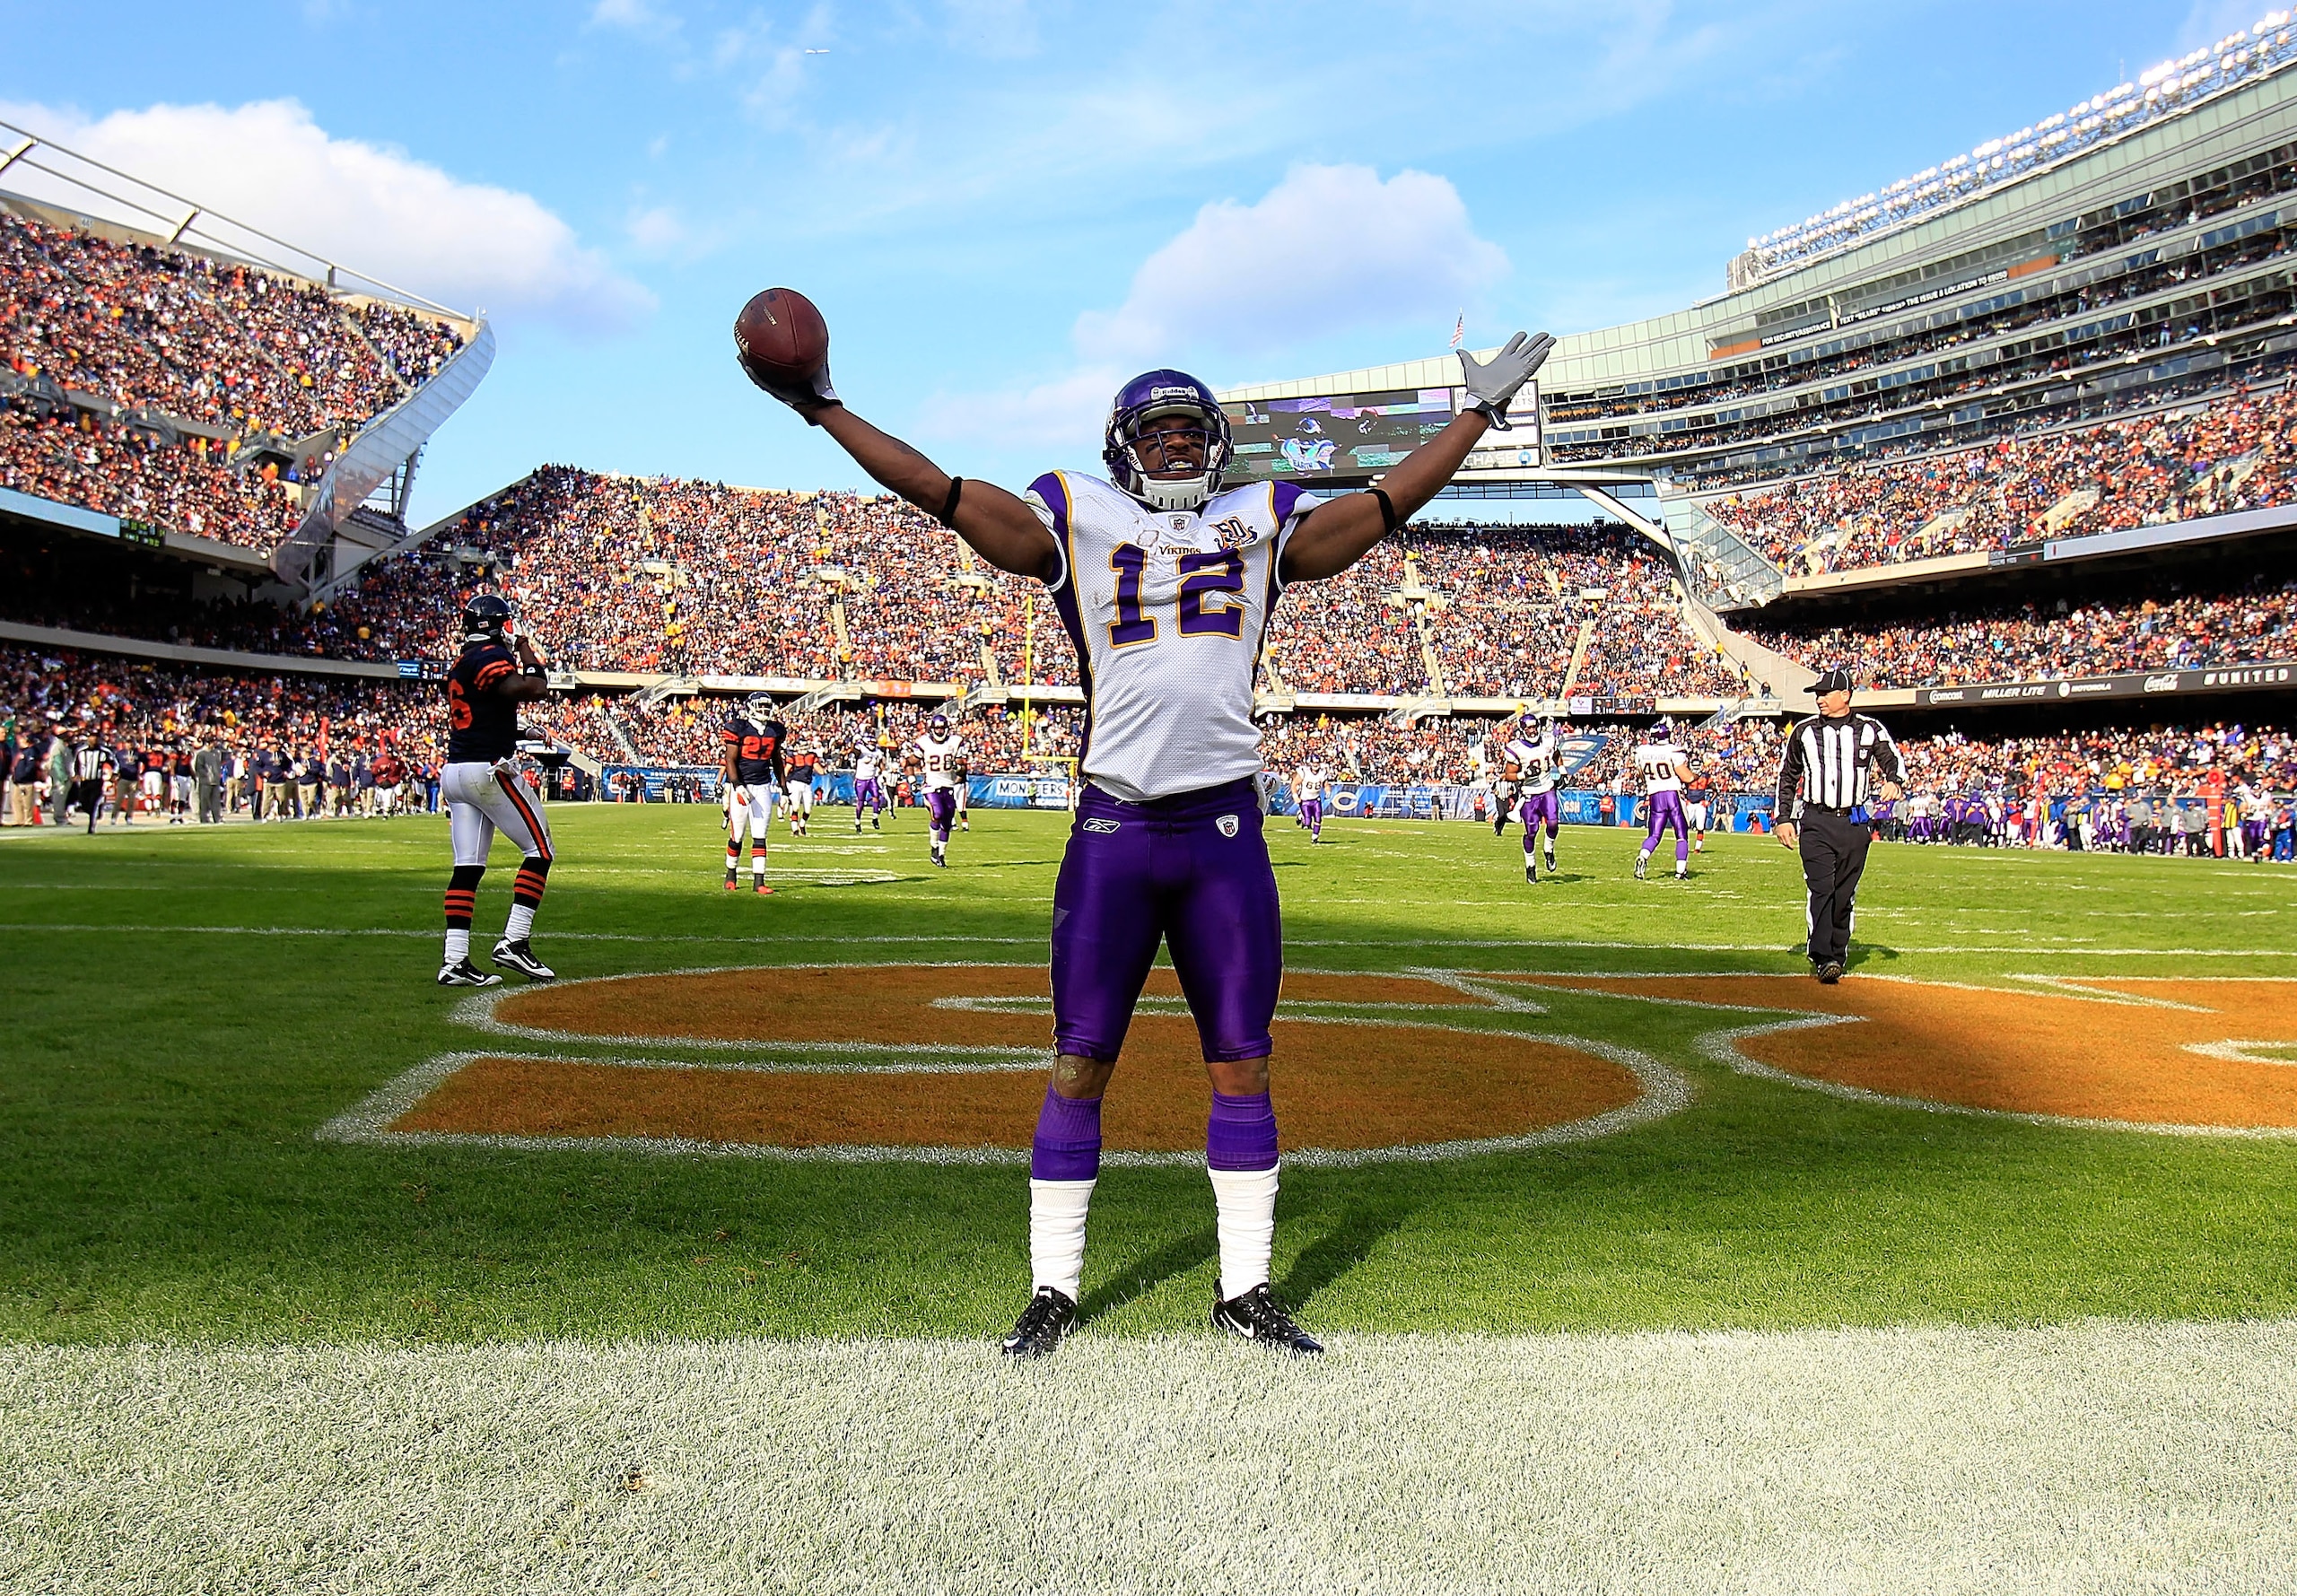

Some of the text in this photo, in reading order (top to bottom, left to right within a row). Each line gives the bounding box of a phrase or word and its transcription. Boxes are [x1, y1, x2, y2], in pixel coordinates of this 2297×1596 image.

[1944, 280, 1978, 296] LOCATION
[1463, 453, 1515, 467] CHASE
[1108, 540, 1247, 650] 12
[2219, 667, 2289, 685] UNITED
[1981, 685, 2047, 699] MILLER LITE
[2071, 683, 2112, 693] MOTOROLA
[1929, 690, 1964, 704] Comcast
[741, 735, 775, 760] 27
[1643, 762, 1672, 781] 40
[1000, 782, 1063, 792] MONTERS
[1306, 781, 1322, 790] 68
[1564, 800, 1582, 813] GSH
